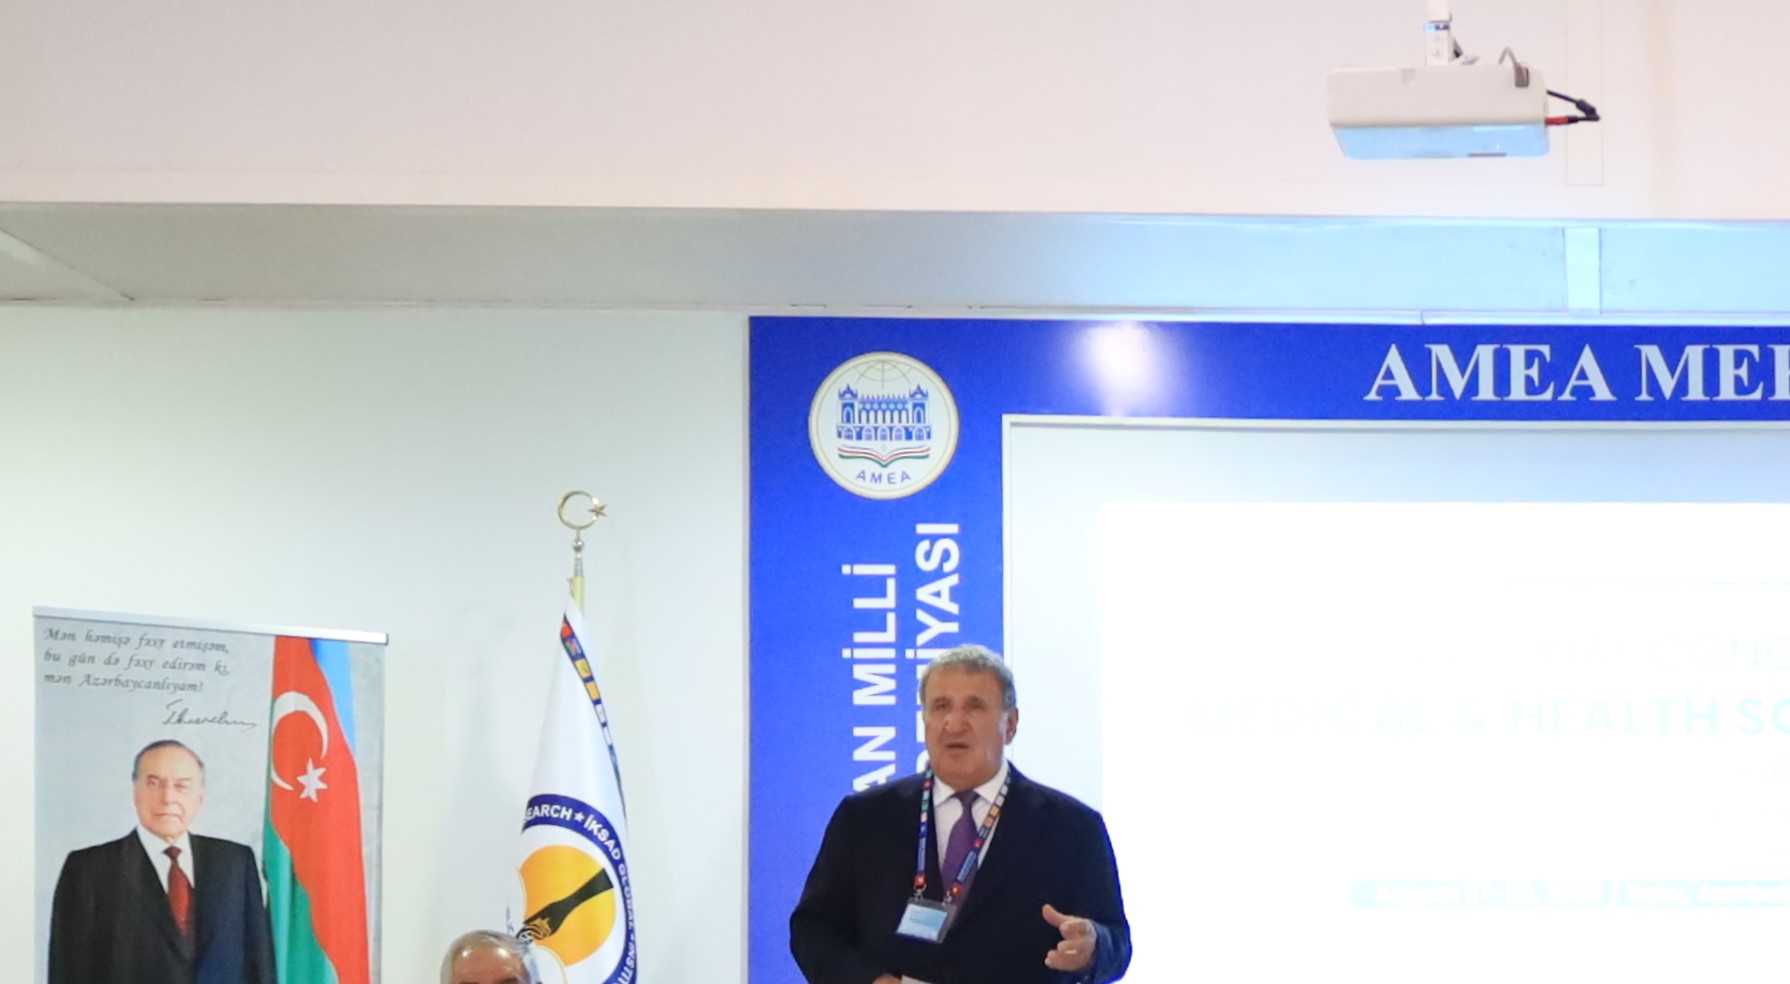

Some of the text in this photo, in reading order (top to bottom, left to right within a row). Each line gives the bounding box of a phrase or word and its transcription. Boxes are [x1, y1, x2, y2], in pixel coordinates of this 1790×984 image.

[1363, 343, 1618, 401] AMEA
[856, 469, 912, 485] AMEA
[43, 627, 77, 642] Mən
[43, 647, 61, 662] bu
[68, 650, 96, 667] gün
[103, 652, 120, 666] də
[43, 673, 72, 685] mən
[841, 563, 897, 793] AN MİLLİ
[1509, 696, 1720, 737] HEALTH
[524, 803, 573, 821] EARCH
[583, 814, 621, 861] İKSAD
